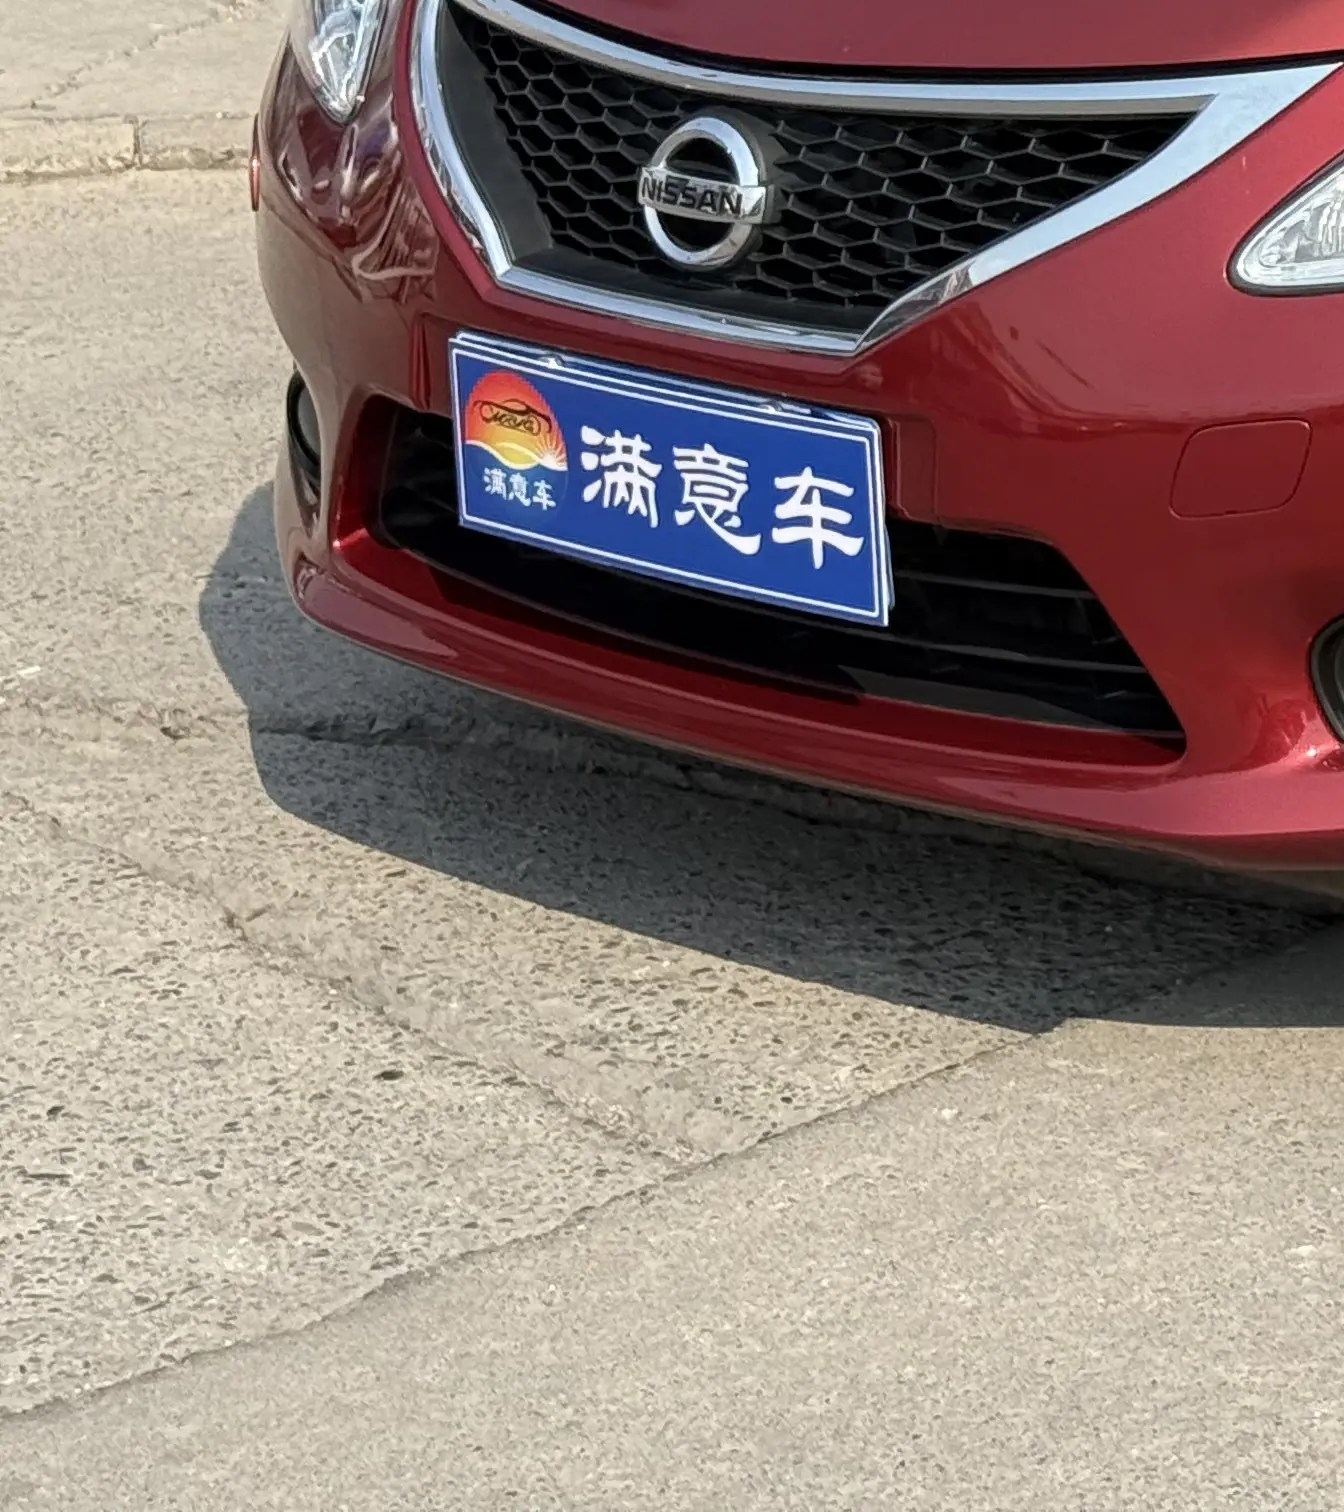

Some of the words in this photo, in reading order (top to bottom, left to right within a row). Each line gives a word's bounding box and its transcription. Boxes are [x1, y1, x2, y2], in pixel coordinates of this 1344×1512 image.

[641, 174, 743, 219] NISSAN
[482, 467, 557, 511] 满意车
[579, 425, 865, 570] 满意车
